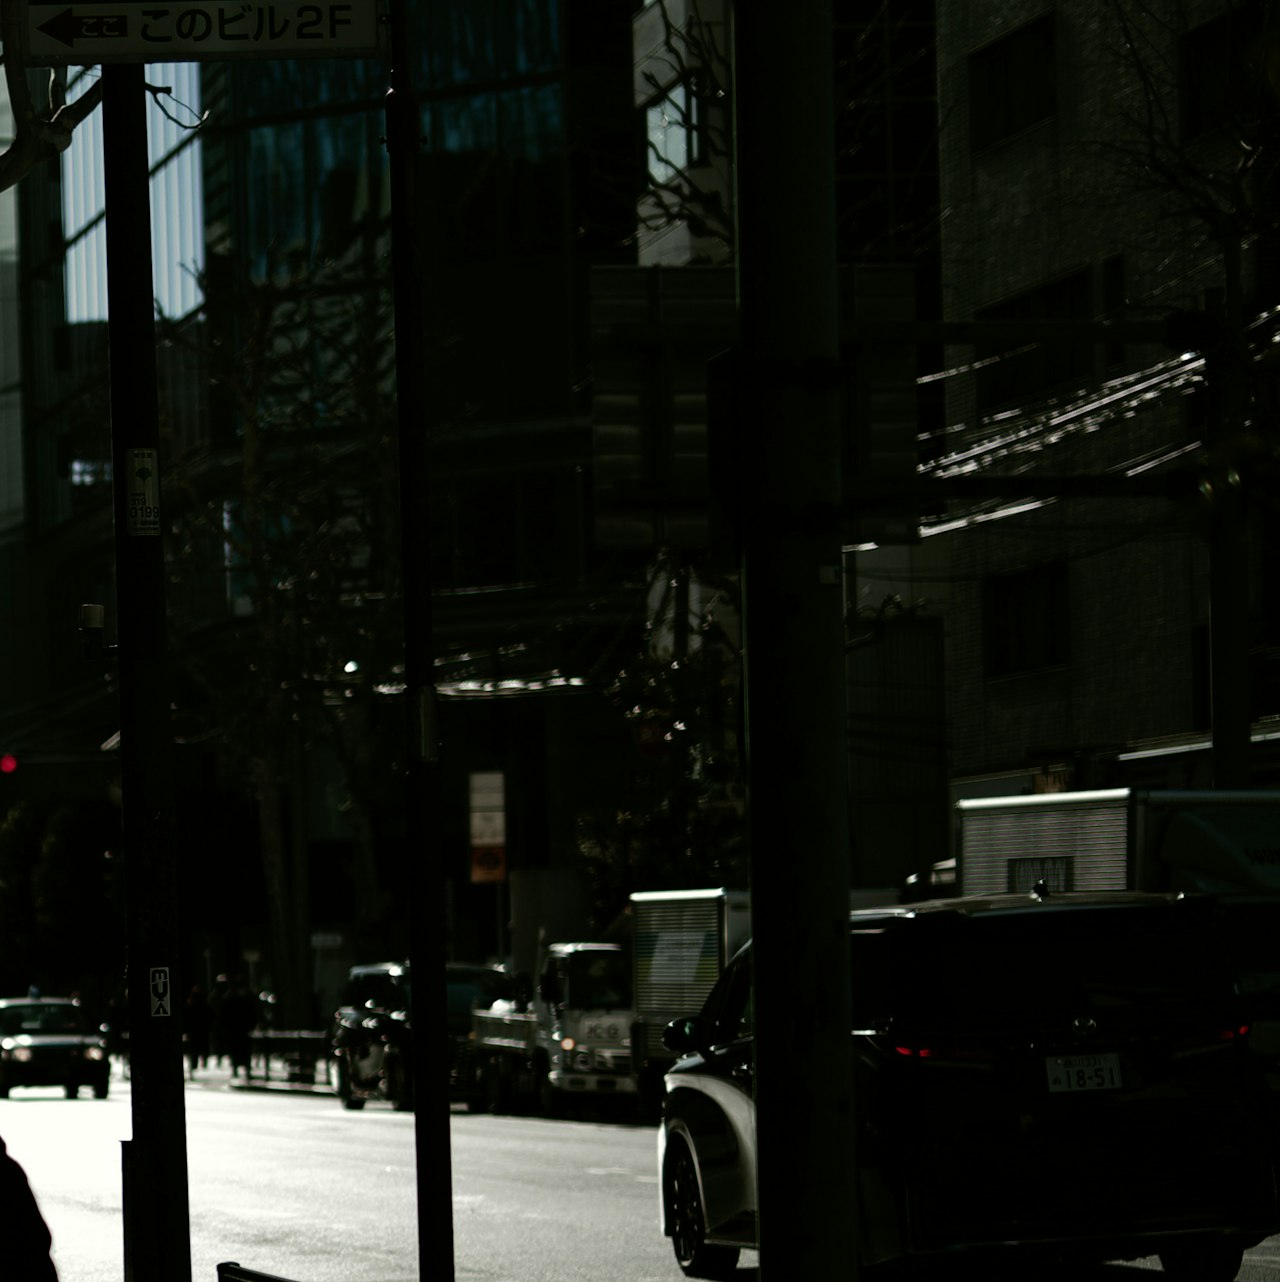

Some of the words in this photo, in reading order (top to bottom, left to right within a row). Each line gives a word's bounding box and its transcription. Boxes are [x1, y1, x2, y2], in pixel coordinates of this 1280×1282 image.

[81, 16, 121, 38] ここ
[140, 4, 352, 42] このビル2F
[1066, 1066, 1115, 1089] 18-51
